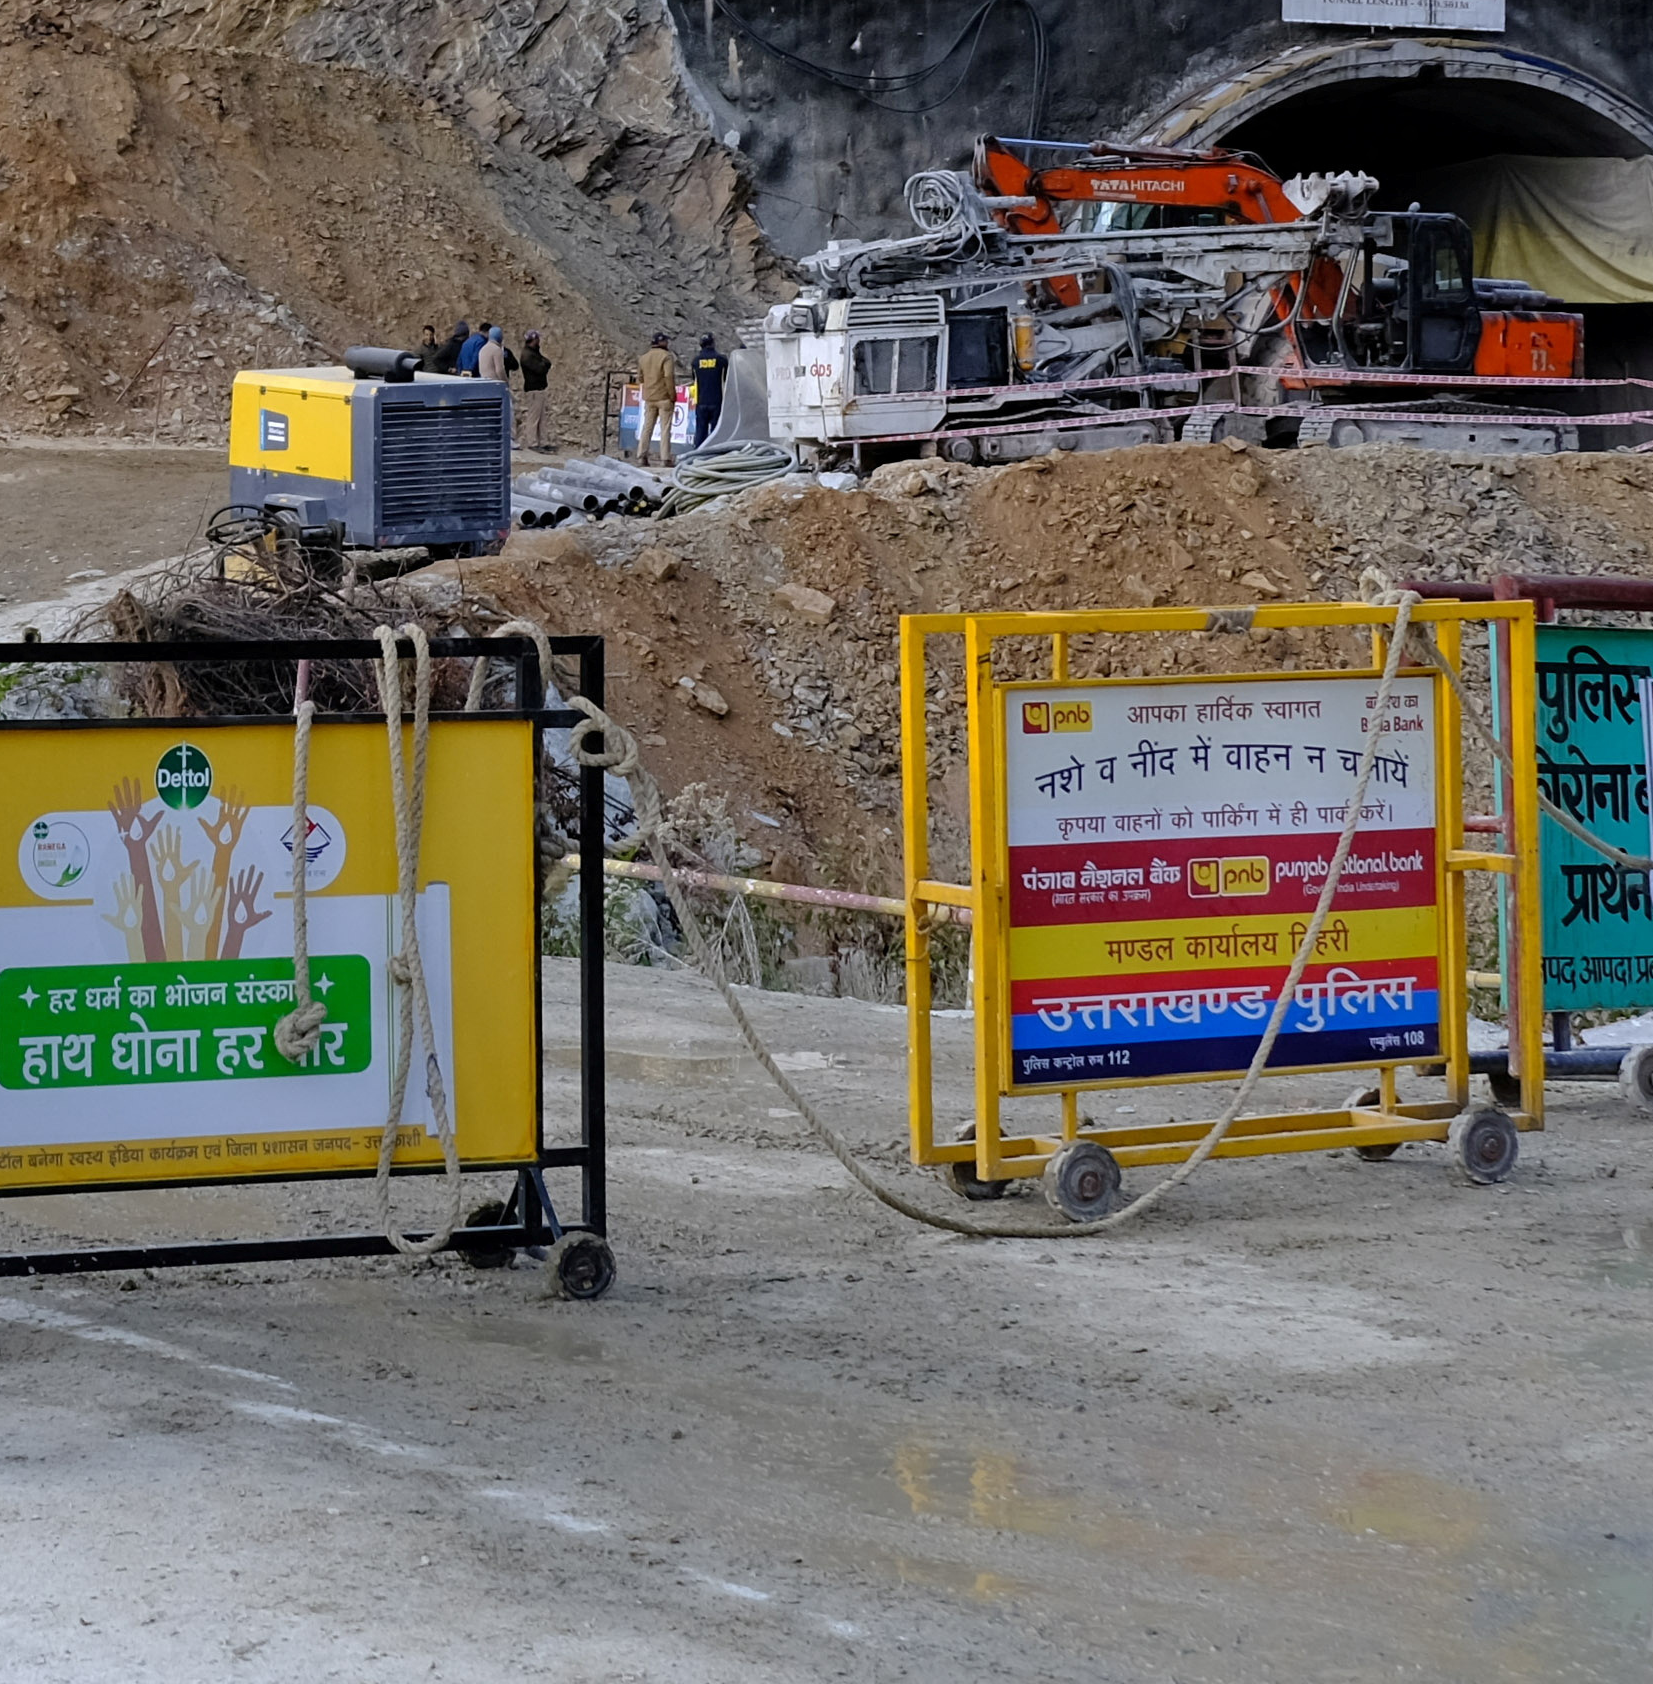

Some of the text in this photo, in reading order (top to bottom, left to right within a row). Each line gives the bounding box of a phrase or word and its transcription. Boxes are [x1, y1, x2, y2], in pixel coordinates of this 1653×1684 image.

[1090, 179, 1185, 192] TATA HITACHI
[1053, 704, 1090, 731] pnb
[1127, 695, 1322, 724] आपका हार्दिक स्वागत
[1394, 714, 1424, 732] Bank
[157, 767, 210, 789] Dettol
[1035, 754, 1085, 800] नशे
[1095, 756, 1117, 784] व
[1127, 738, 1178, 779] नींद
[1189, 734, 1212, 772] में
[1222, 743, 1293, 774] वाहन
[1303, 745, 1326, 774] न
[1056, 815, 1107, 841] कृपया
[1112, 807, 1163, 834] वाहनों
[1170, 805, 1194, 829] को
[1201, 803, 1259, 828] पार्किंग
[1265, 802, 1282, 826] में
[1289, 800, 1308, 827] ही
[1021, 857, 1182, 891] पंजाब नैशनल बैंक
[1224, 862, 1265, 891] pnb
[1275, 849, 1424, 883] punjab ational bank
[1104, 937, 1175, 964] मण्डल
[1184, 923, 1279, 959] कार्यालय
[1579, 956, 1633, 987] आपदा
[48, 974, 298, 1014] हर धर्म का भोजन संस्का
[1031, 966, 1418, 1034] उत्तराखण्ड पुलिस
[19, 1033, 96, 1085] हाथ
[111, 1012, 201, 1076] धोना
[213, 1026, 267, 1076] हर
[1403, 1030, 1425, 1047] 108
[1022, 1054, 1051, 1076] पुलिस
[1107, 1049, 1131, 1065] 112
[28, 1148, 63, 1168] बनेगा
[107, 1143, 144, 1168] इंडिया
[148, 1140, 199, 1161] कार्यक्रम
[203, 1139, 221, 1160] एवं
[226, 1137, 257, 1157] जिला
[262, 1139, 308, 1157] प्रशासन
